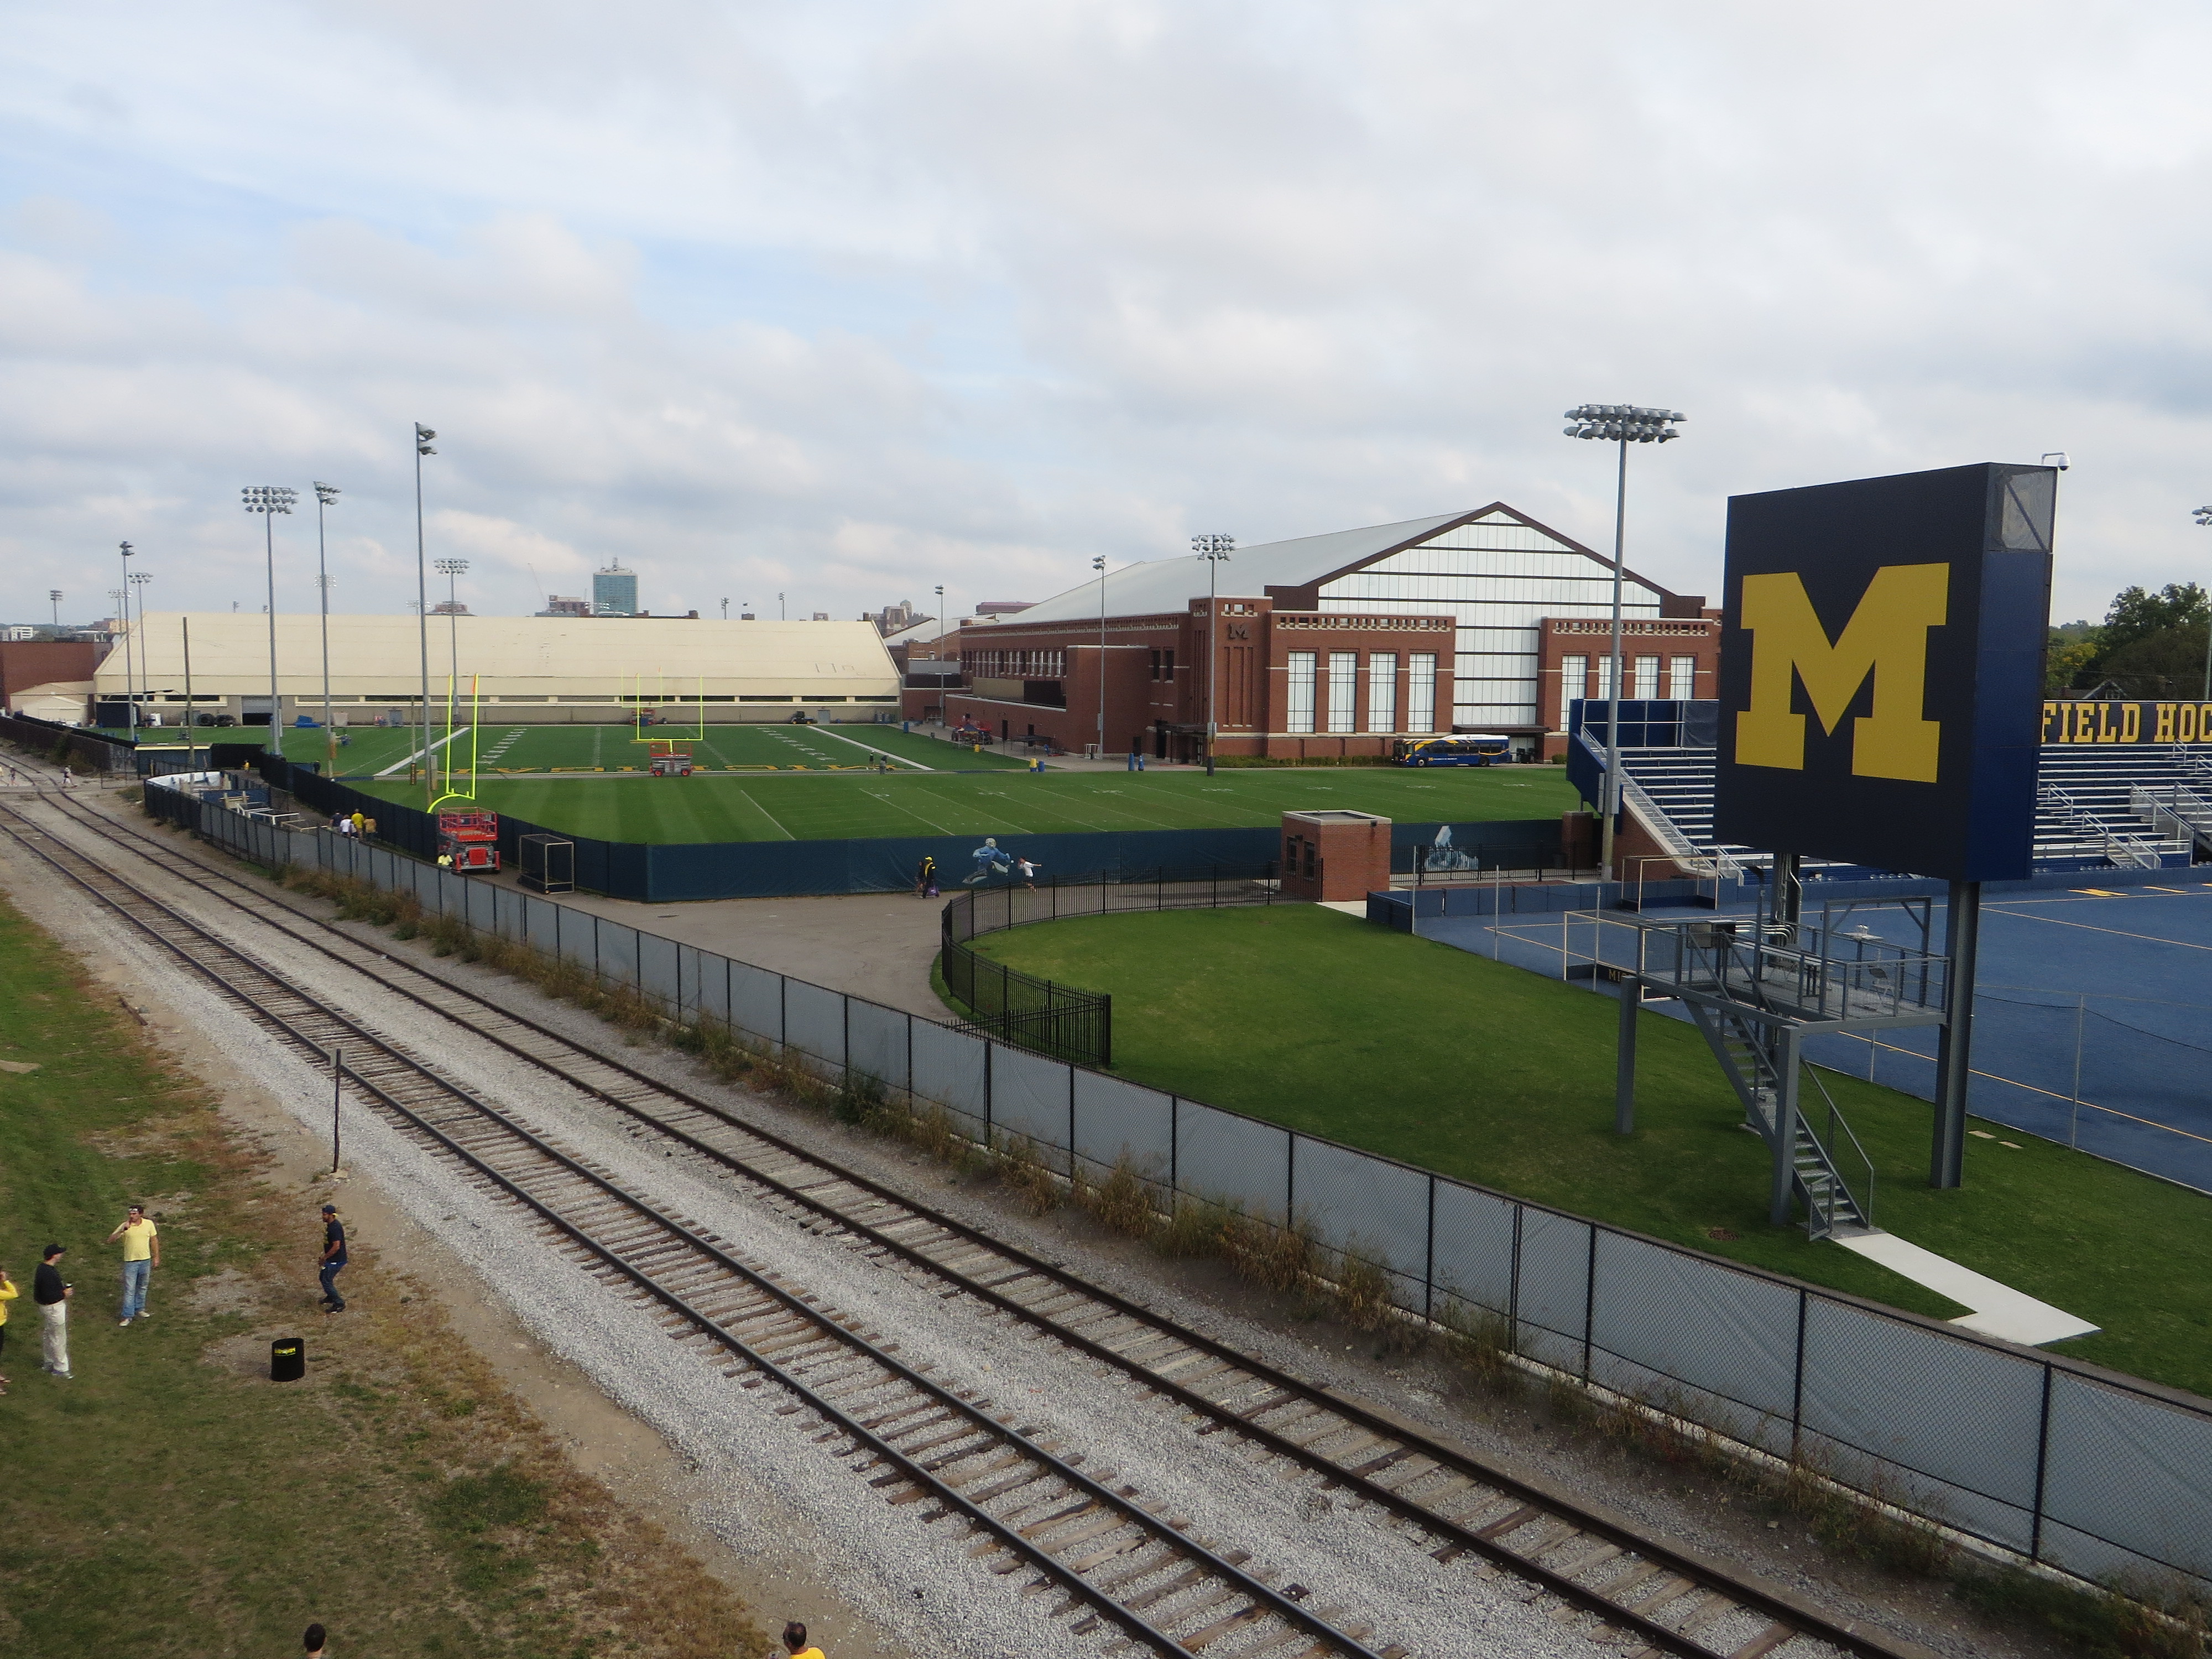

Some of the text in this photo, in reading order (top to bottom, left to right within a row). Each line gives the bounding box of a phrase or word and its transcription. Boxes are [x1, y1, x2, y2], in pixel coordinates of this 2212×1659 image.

[1228, 622, 1250, 639] M
[1735, 562, 1949, 784] M
[2041, 703, 2141, 743] FIELD
